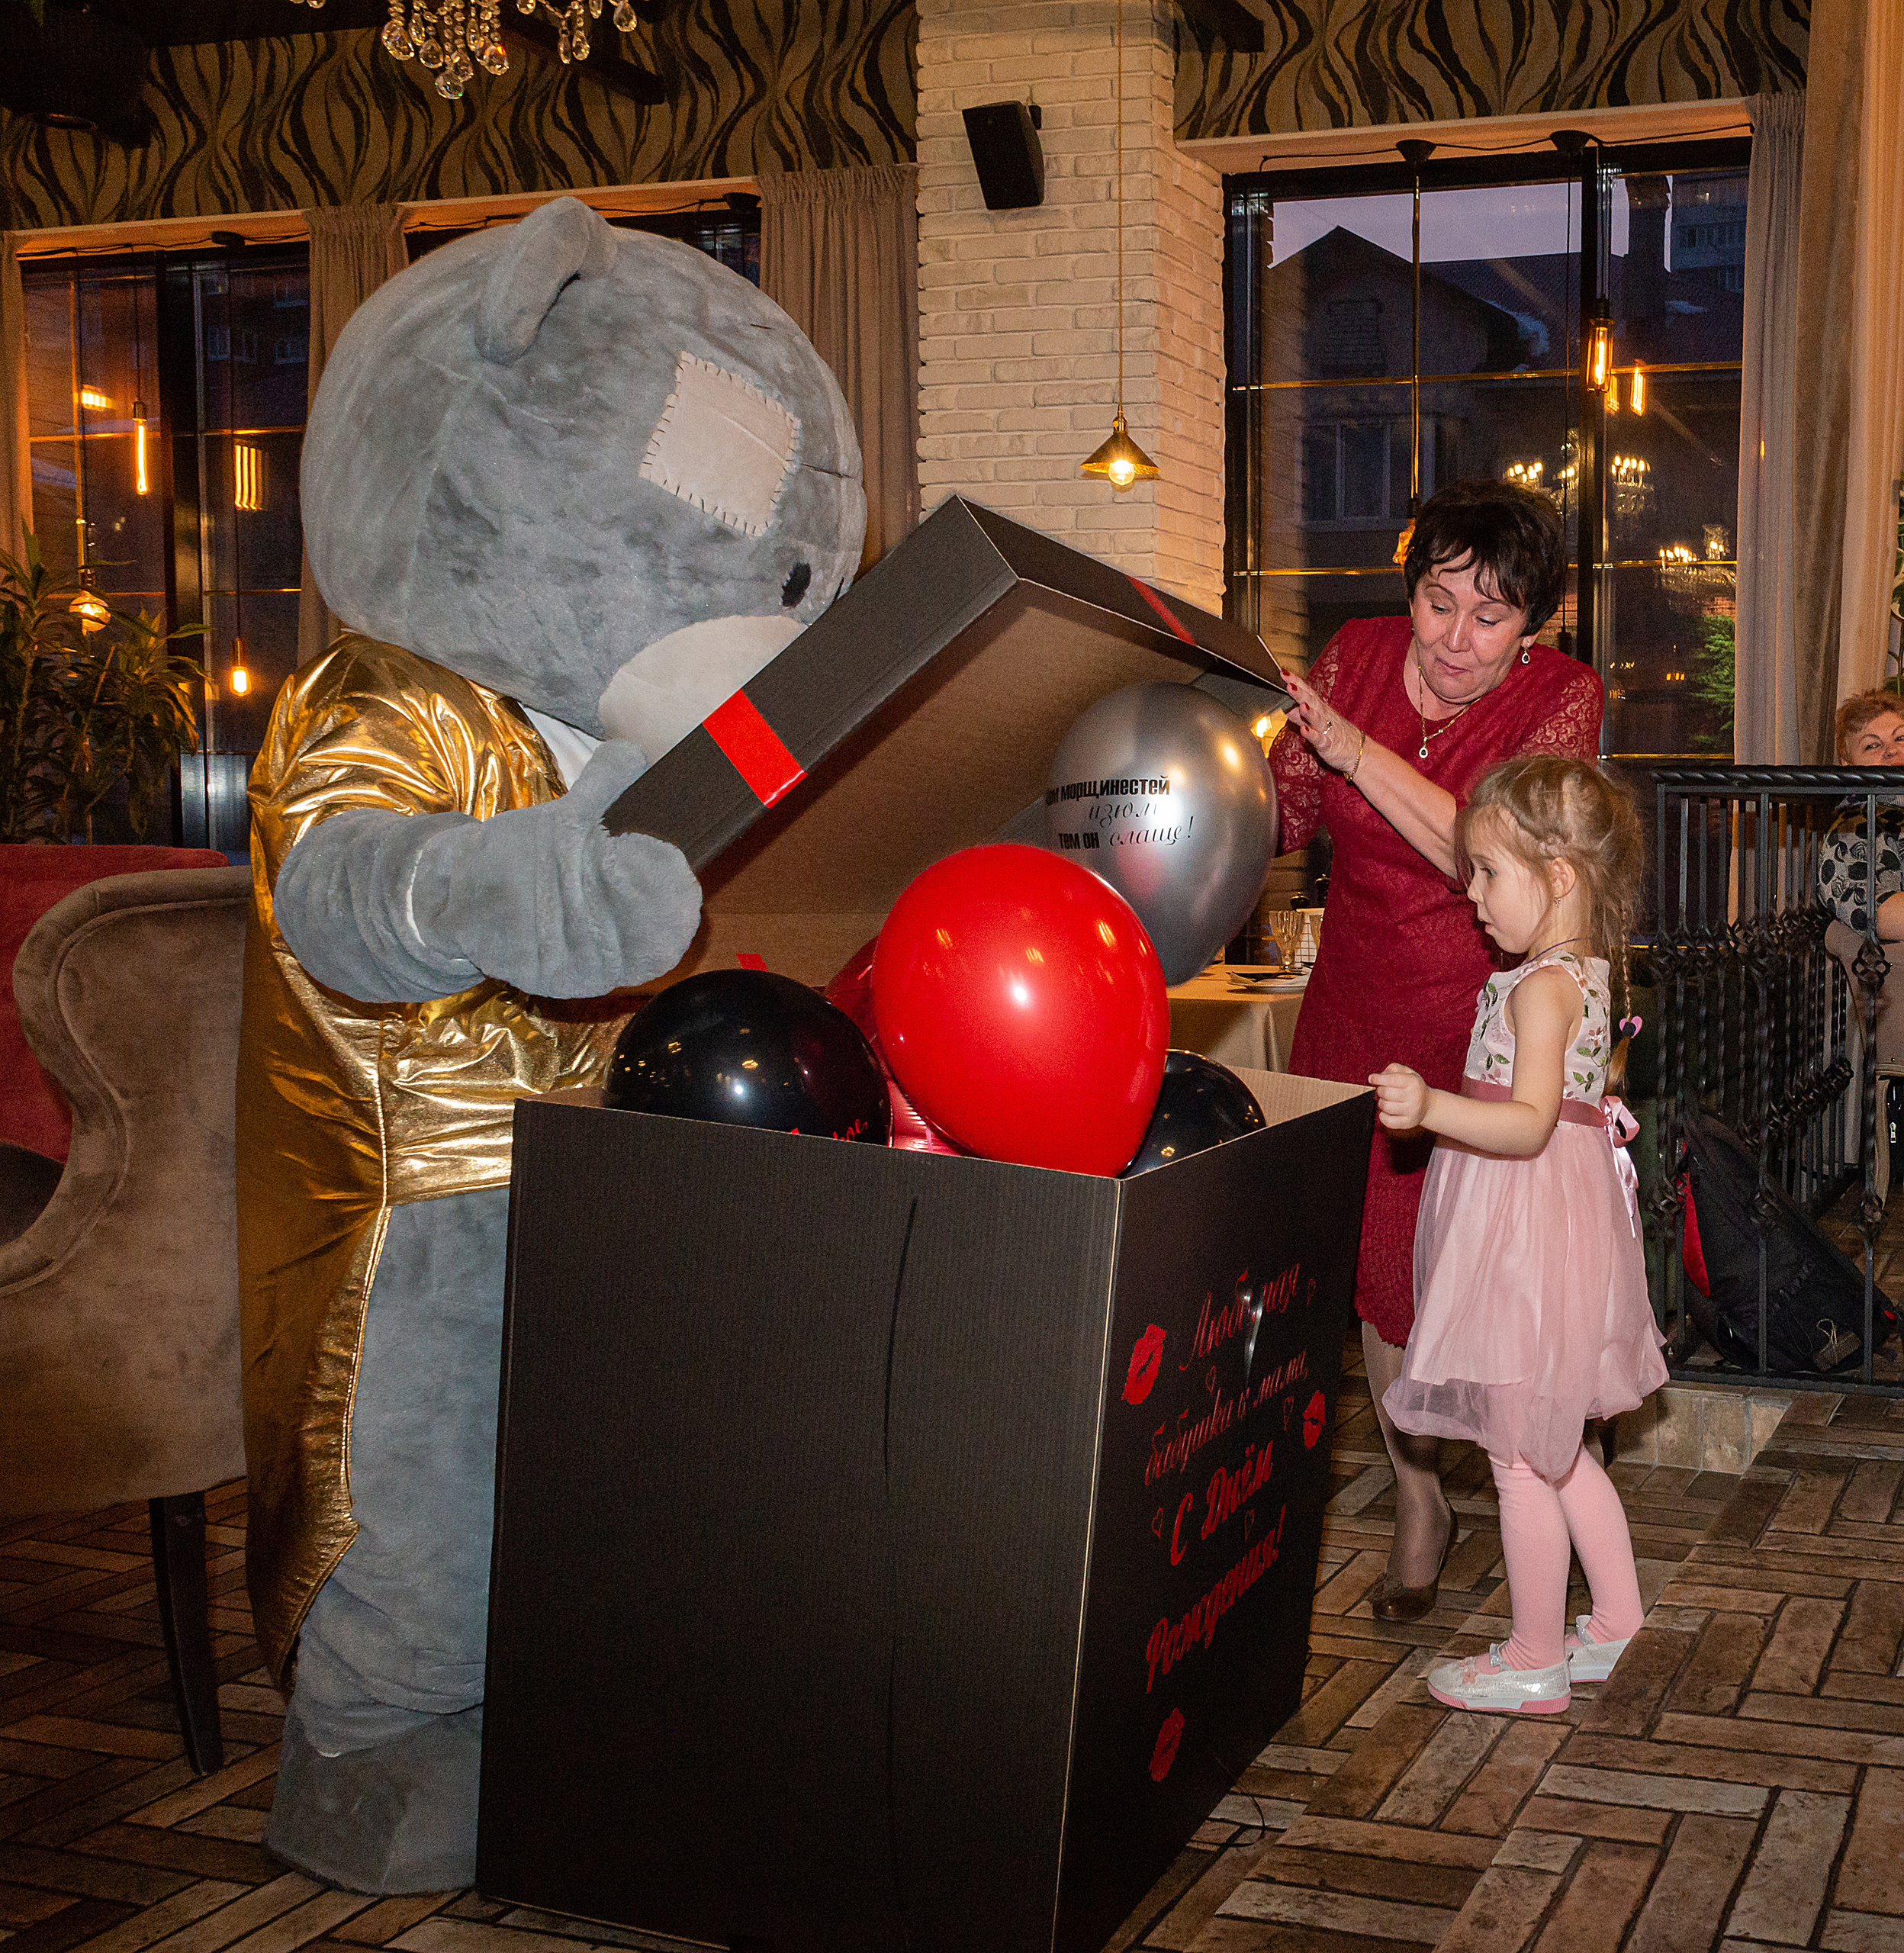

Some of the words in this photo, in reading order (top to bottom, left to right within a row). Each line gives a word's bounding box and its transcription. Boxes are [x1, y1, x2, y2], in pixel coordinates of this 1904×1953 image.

[1060, 774, 1171, 801] морщинестей
[1089, 802, 1157, 828] изюм
[1058, 832, 1081, 850] тем
[1083, 832, 1100, 849] он
[1109, 816, 1195, 847] слаще!
[1145, 1387, 1234, 1486] бабушка
[1237, 1387, 1250, 1420] и
[1170, 1492, 1193, 1565] С
[1201, 1440, 1274, 1540] Днём
[1146, 1503, 1286, 1694] Рождения!
